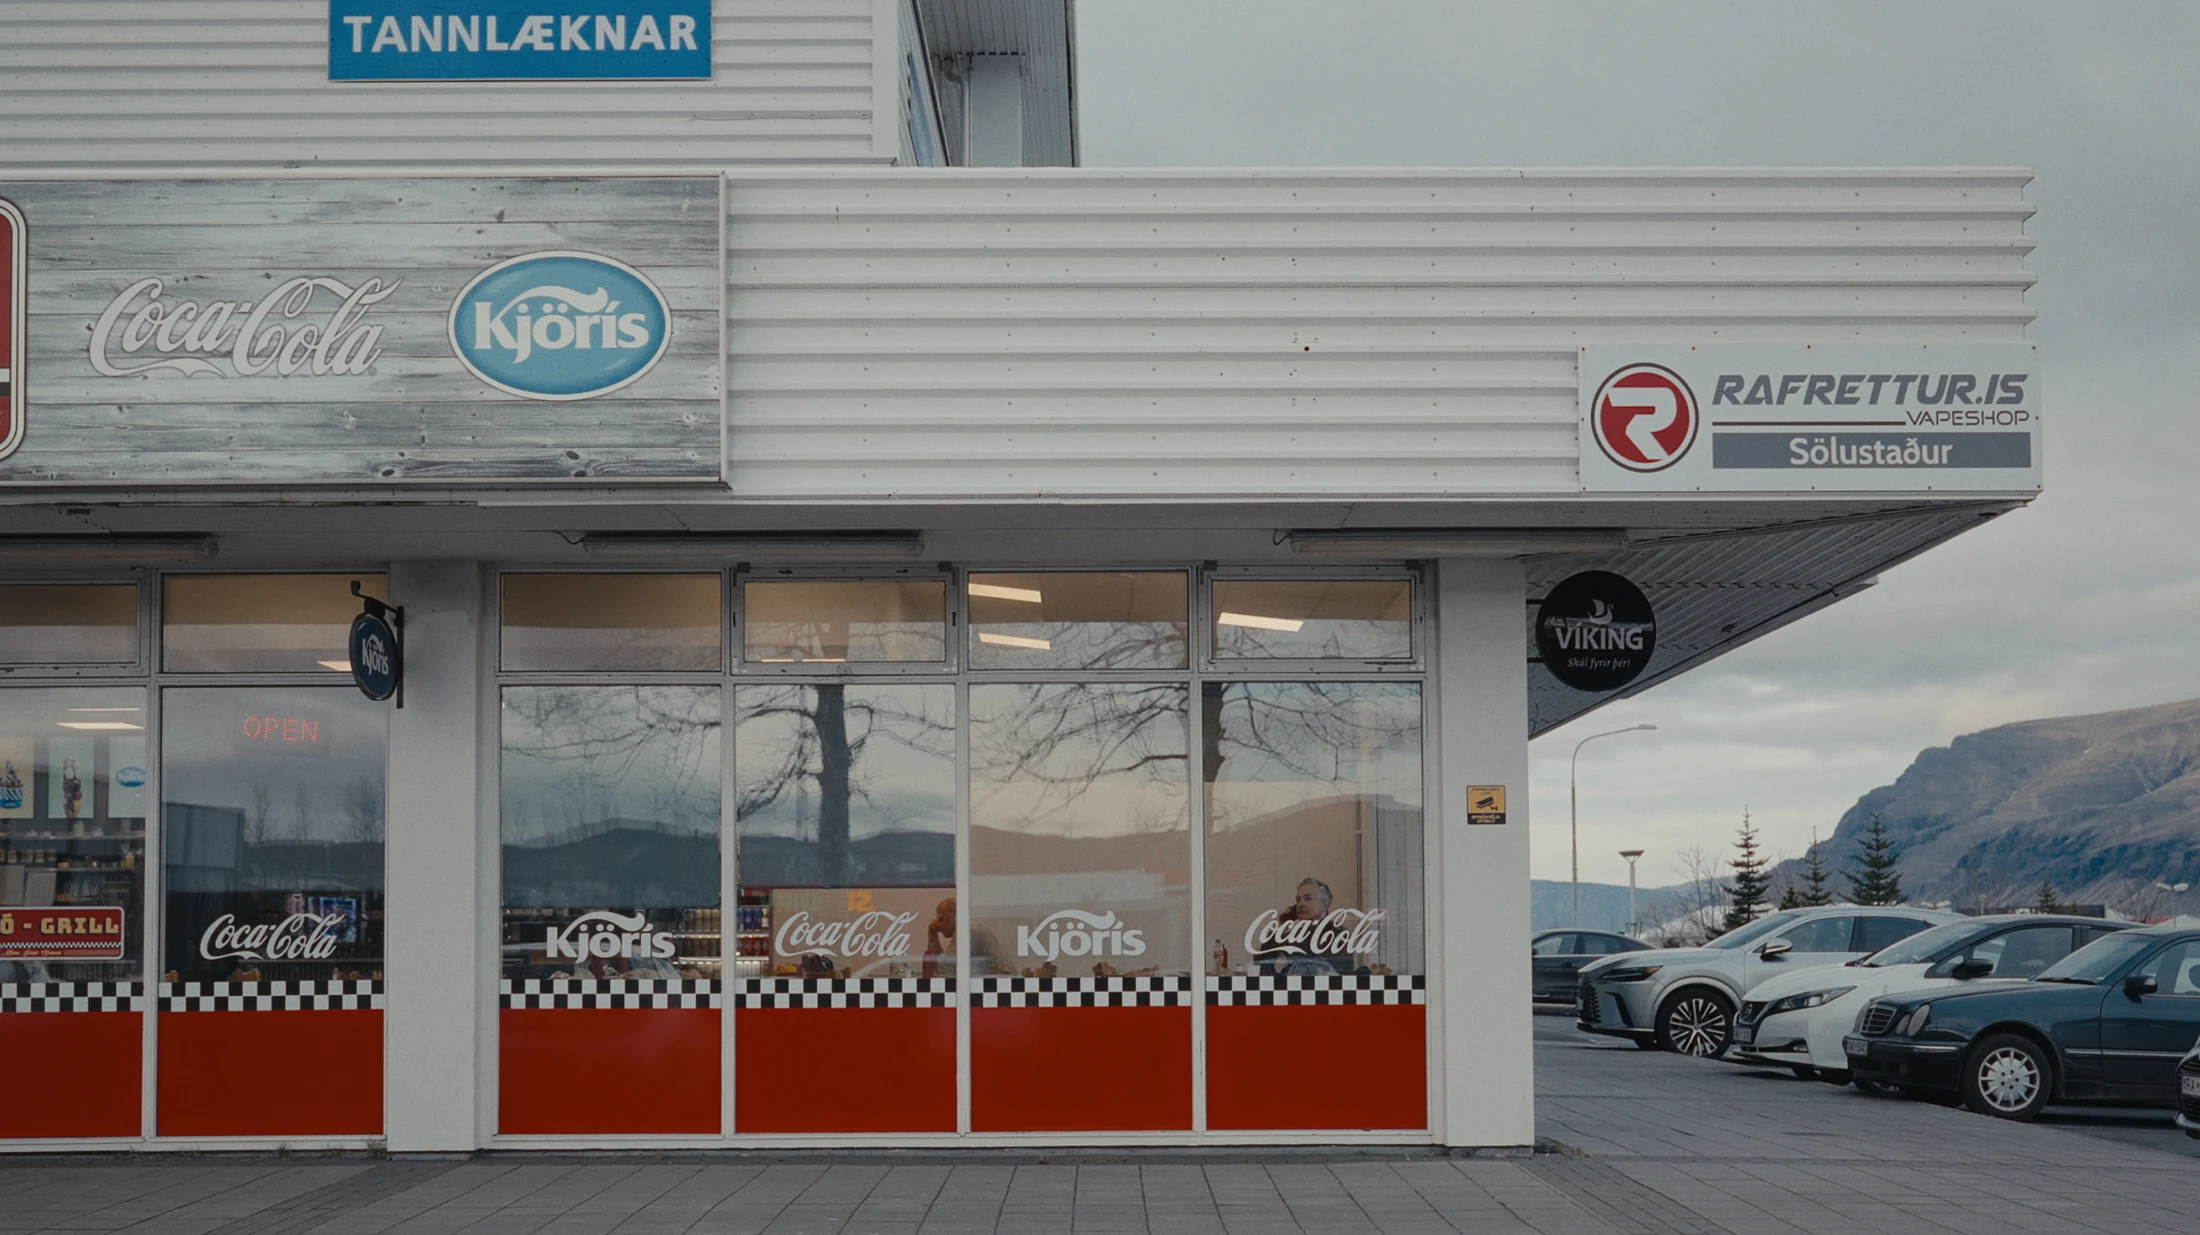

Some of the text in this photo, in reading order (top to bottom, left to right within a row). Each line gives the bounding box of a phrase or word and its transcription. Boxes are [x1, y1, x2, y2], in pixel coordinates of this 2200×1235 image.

[344, 15, 698, 53] TANNLÆKNAR
[89, 277, 402, 377] Coca-Cola
[474, 285, 651, 364] Kjörís
[1712, 374, 2029, 406] RAFRETTUR.IS
[1906, 410, 2030, 426] VAPESHOP
[1789, 437, 1953, 466] Sölustaður
[1554, 621, 1644, 651] VÍKING
[1567, 657, 1588, 668] Skál
[1588, 657, 1611, 670] fyrir
[243, 716, 318, 742] OPEN
[41, 917, 119, 935] GRILL
[200, 913, 346, 960] Coca-Cola
[546, 911, 676, 963] Kjörís
[774, 911, 919, 957] Coca-Cola
[1017, 909, 1146, 962] Kjörís
[1244, 908, 1387, 955] Coca-Cola
